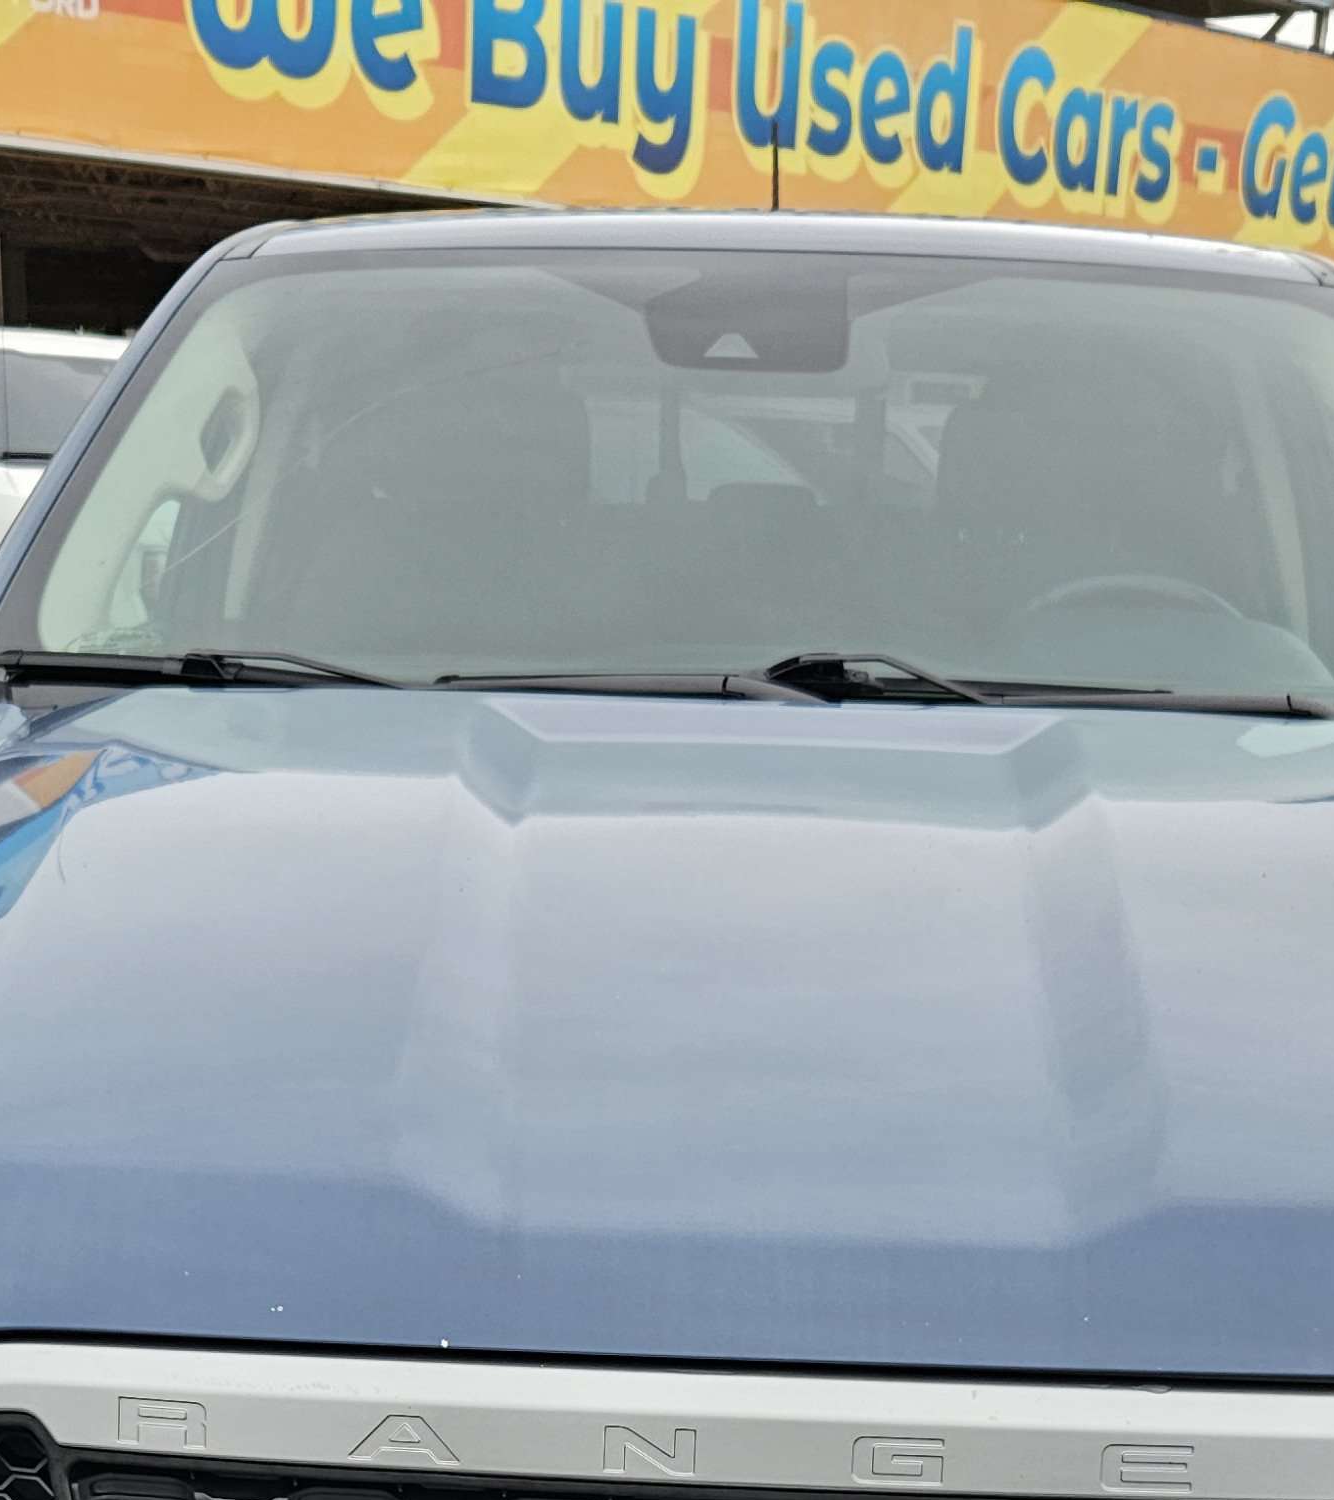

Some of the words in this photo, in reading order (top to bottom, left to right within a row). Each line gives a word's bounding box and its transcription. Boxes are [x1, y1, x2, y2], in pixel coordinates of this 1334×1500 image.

[190, 0, 424, 92] We
[470, 0, 697, 173] Buy
[735, 0, 973, 173] Used
[999, 46, 1175, 202] Cars
